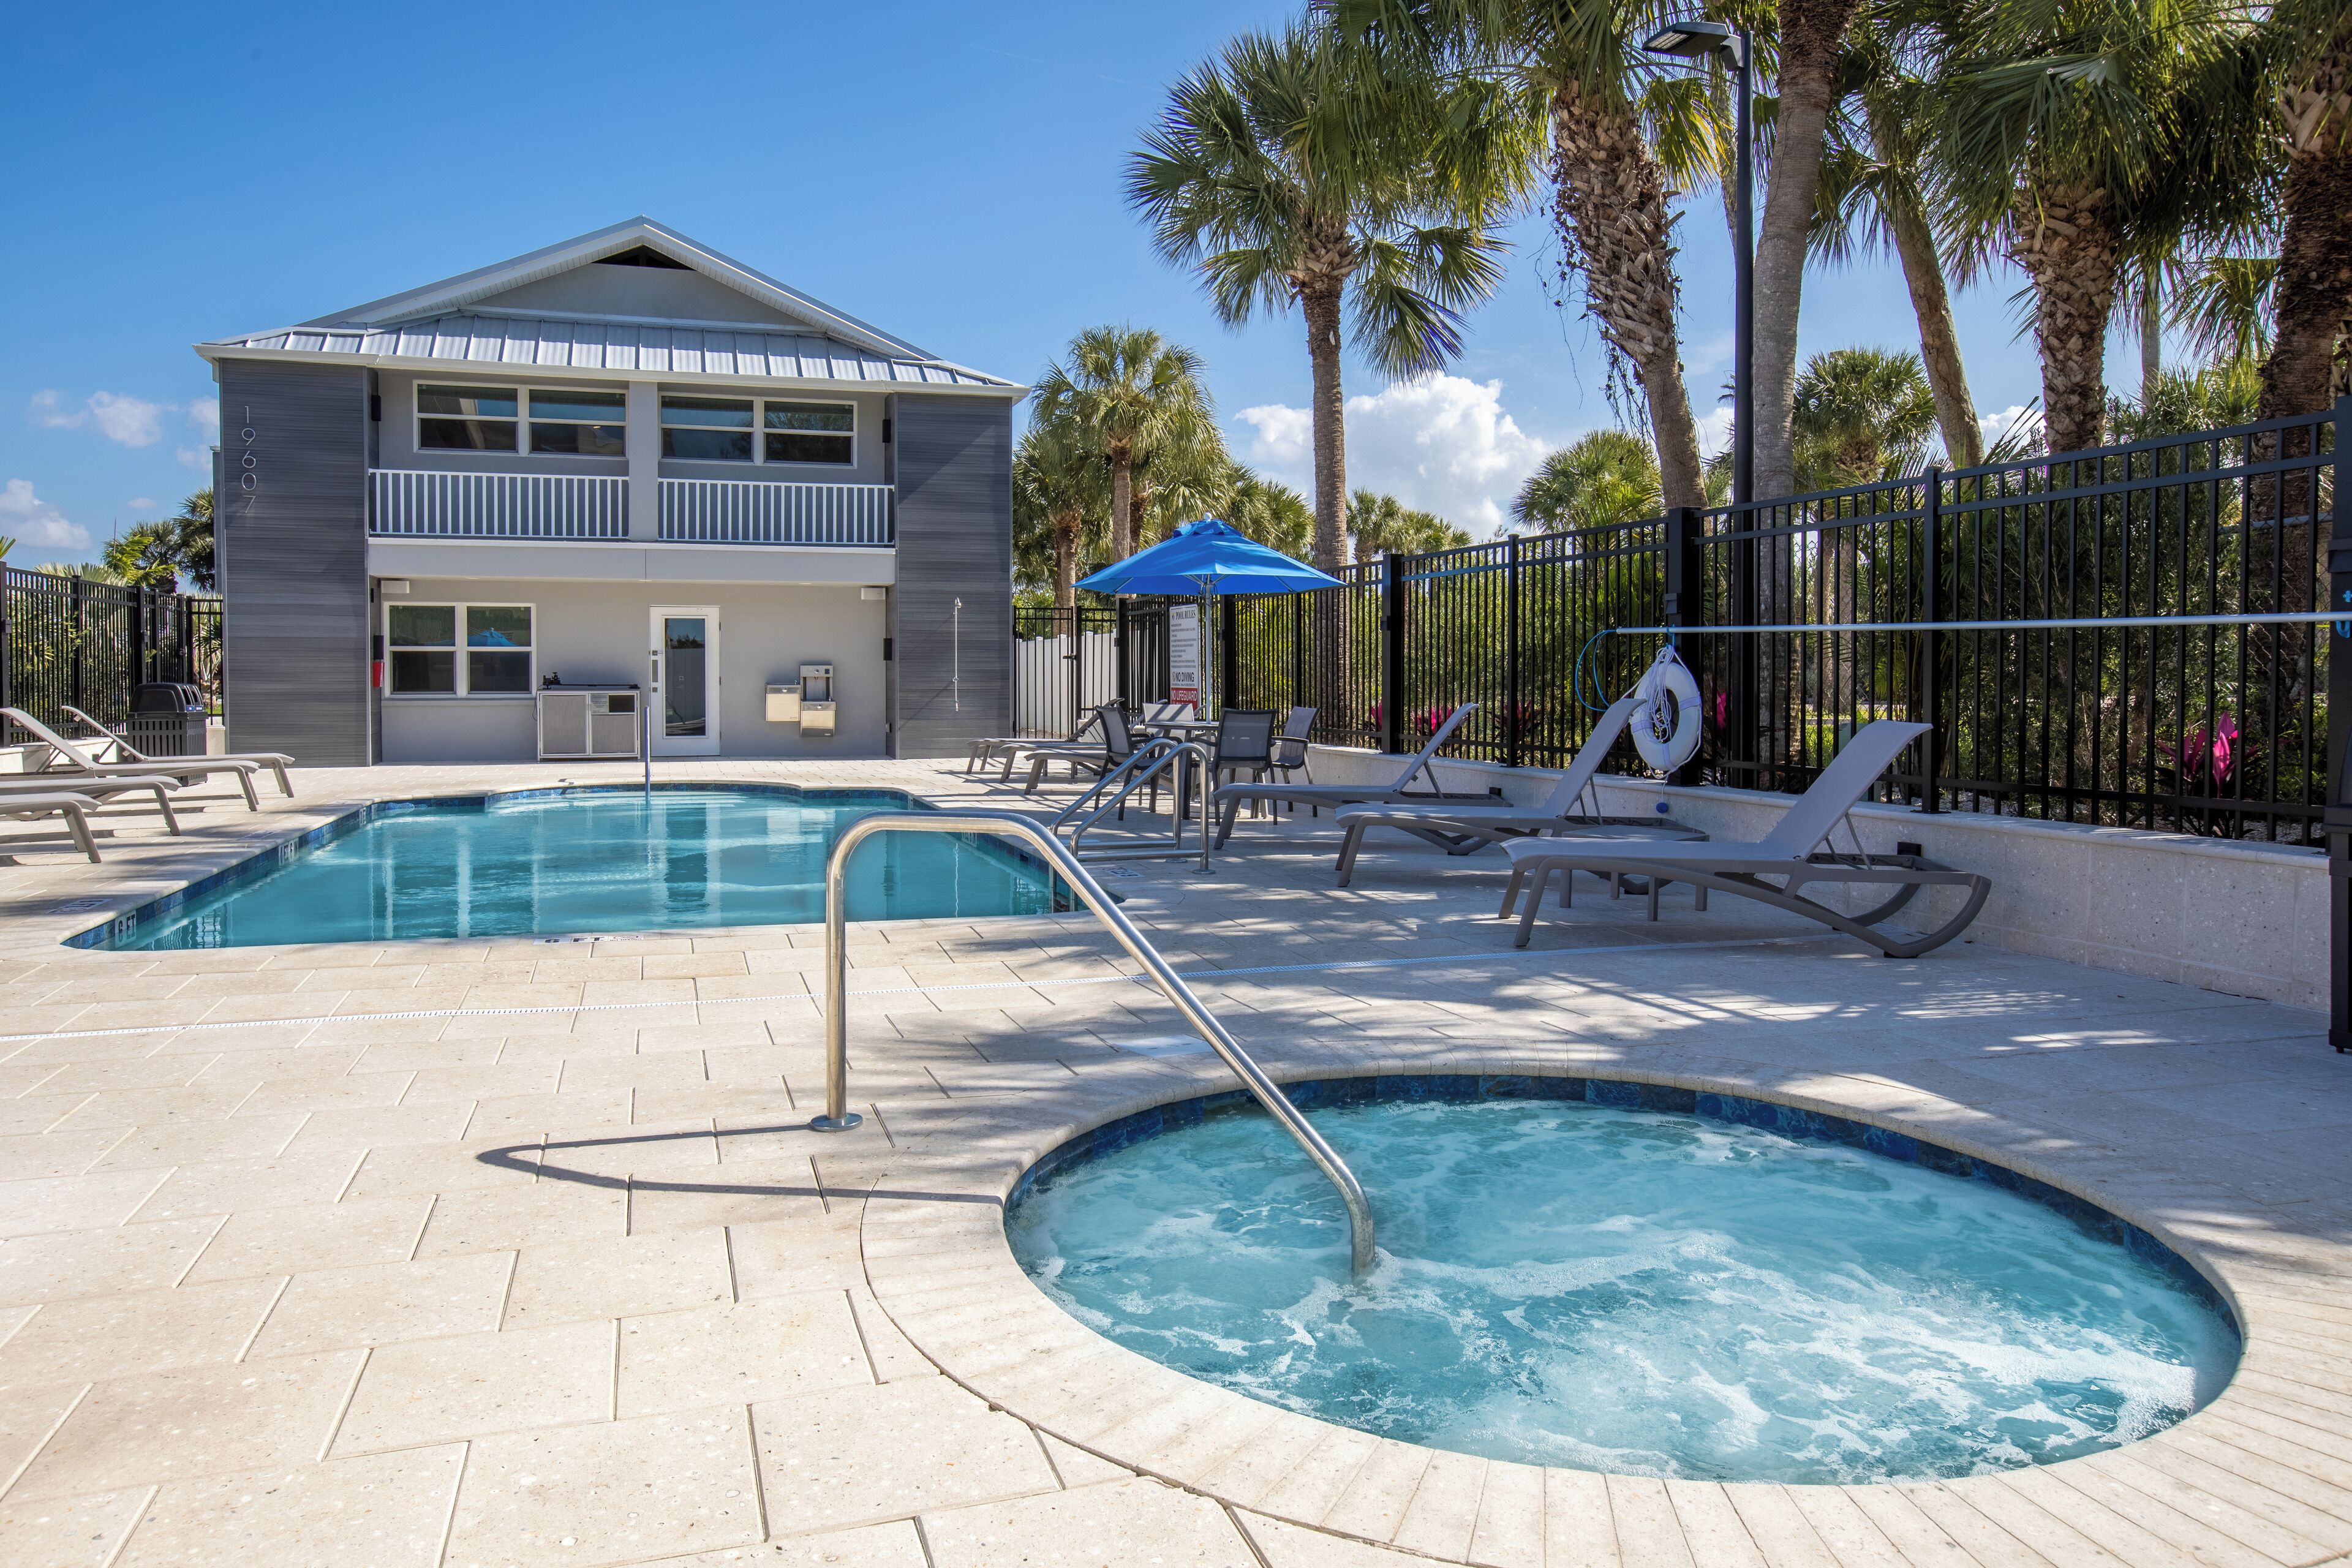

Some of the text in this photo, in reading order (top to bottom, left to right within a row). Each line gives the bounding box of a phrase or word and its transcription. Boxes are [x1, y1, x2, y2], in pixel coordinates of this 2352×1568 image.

[241, 405, 257, 514] 19607
[1175, 609, 1196, 620] POOL RULES
[1175, 672, 1194, 682] NO DIVING
[1171, 690, 1197, 701] NO LIFEGUARD
